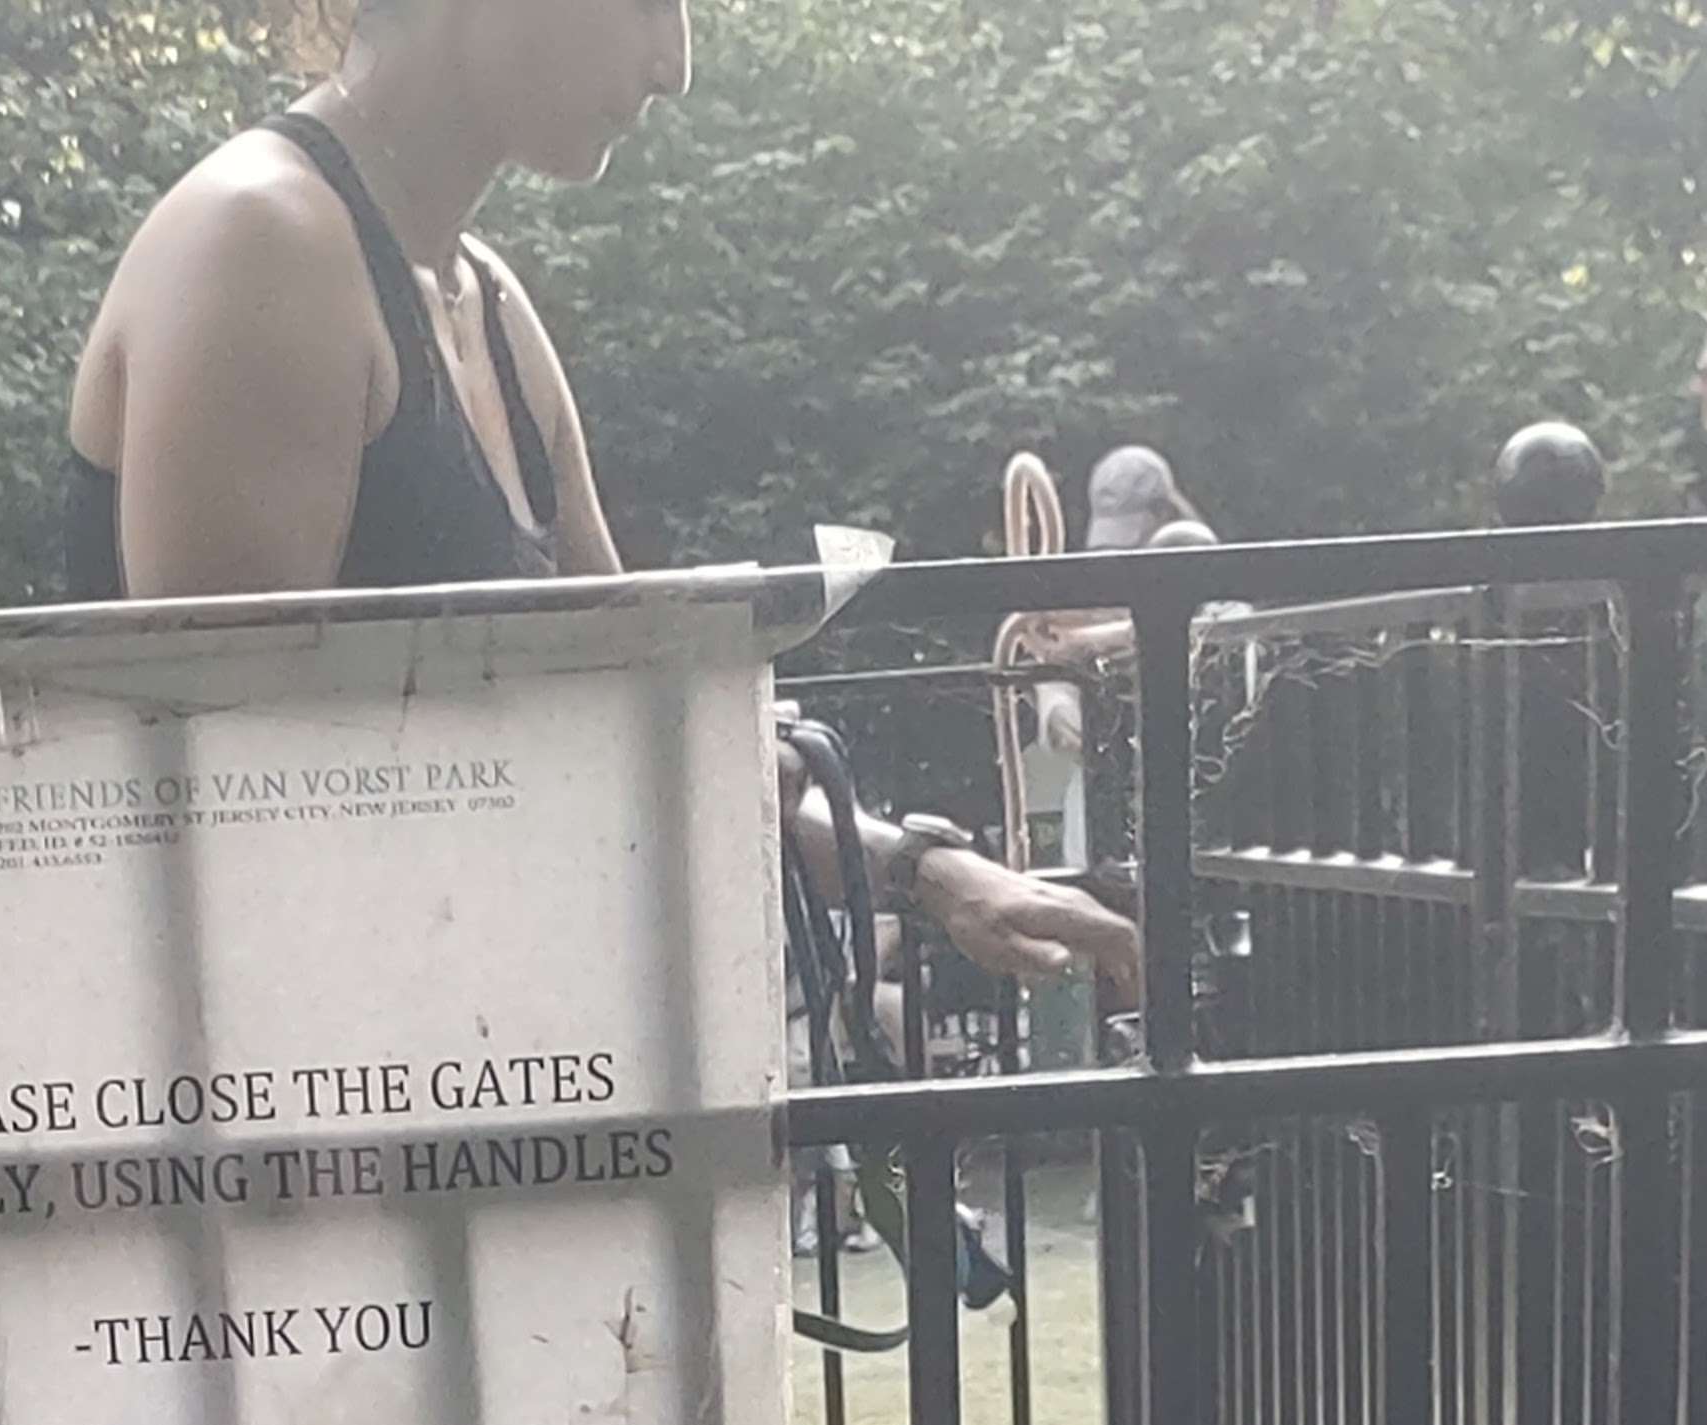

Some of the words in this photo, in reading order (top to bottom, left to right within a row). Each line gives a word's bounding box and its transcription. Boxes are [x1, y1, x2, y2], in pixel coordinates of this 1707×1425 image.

[154, 777, 201, 807] OF
[212, 771, 286, 801] VAN
[301, 765, 411, 797] VORST
[426, 760, 515, 791] PARK
[210, 809, 281, 827] JERSEY
[339, 802, 388, 818] NEW
[390, 798, 456, 817] JERSEY
[95, 1071, 277, 1130] CLOSE
[293, 1063, 413, 1119] THE
[429, 1052, 617, 1110] GATES
[71, 1152, 250, 1212] USING
[264, 1145, 385, 1201] THE
[401, 1128, 675, 1195] HANDLES
[74, 1306, 304, 1368] -THANK
[313, 1300, 435, 1355] YOU
